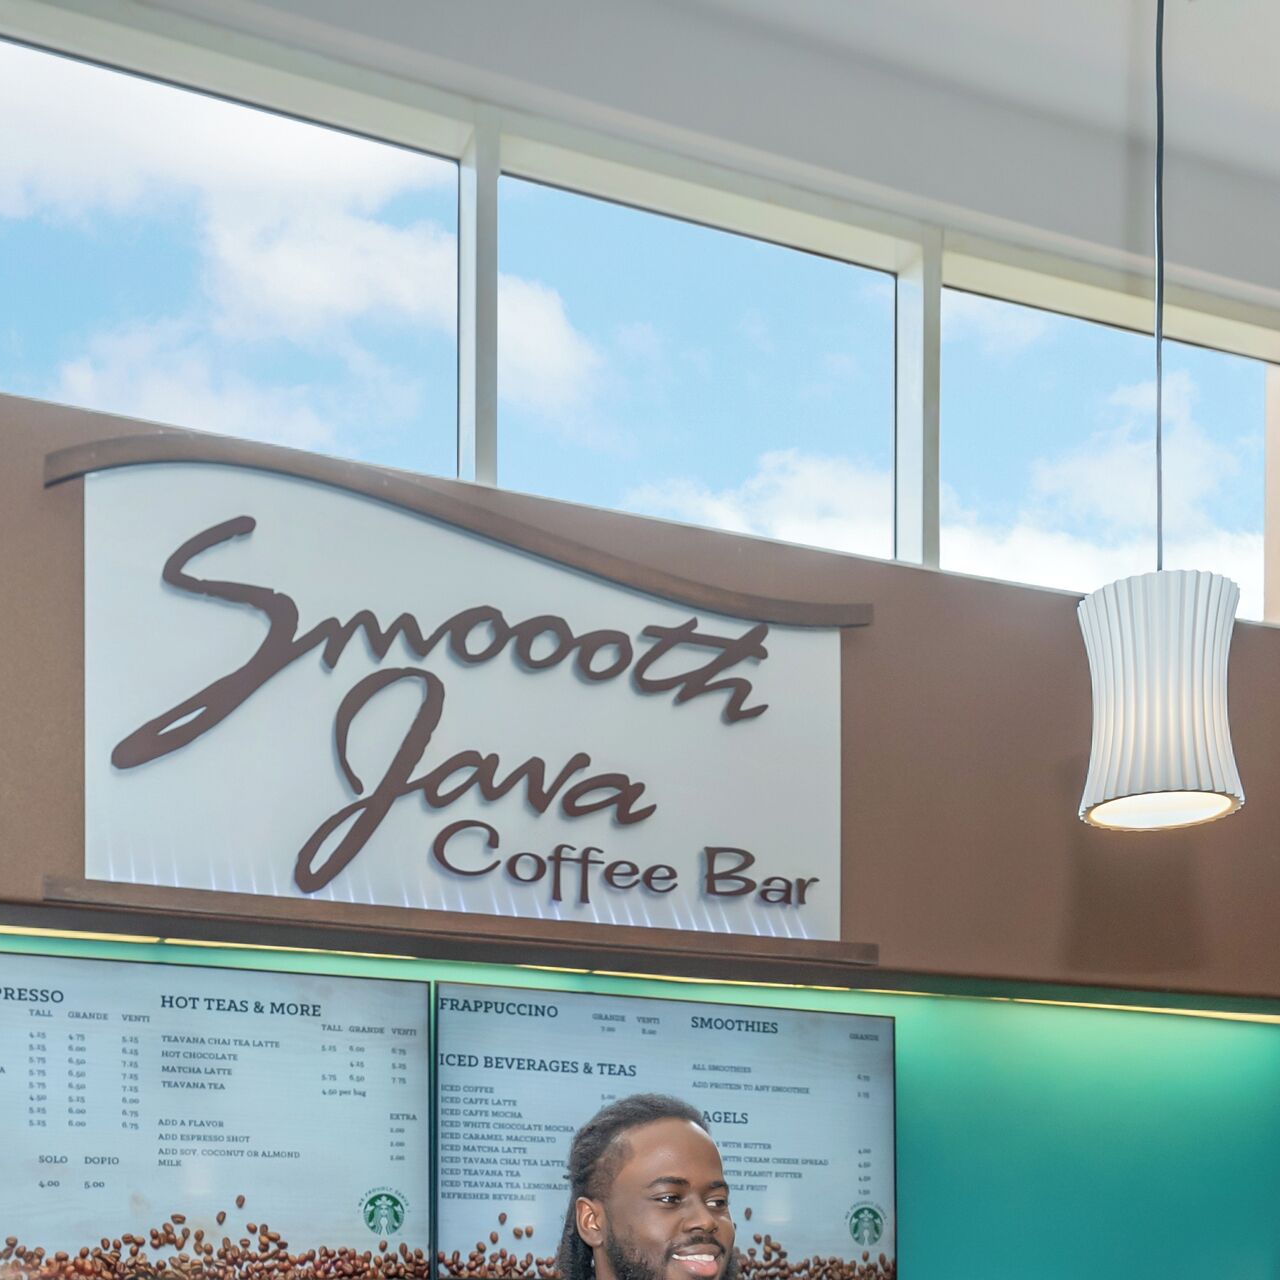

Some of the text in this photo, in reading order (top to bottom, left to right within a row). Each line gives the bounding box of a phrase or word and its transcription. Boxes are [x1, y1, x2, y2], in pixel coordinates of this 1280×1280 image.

[111, 515, 769, 769] Smoooth
[294, 667, 657, 894] Java
[432, 820, 820, 907] Coffee Bar
[161, 996, 322, 1017] HOT TEAS & MORE
[440, 998, 558, 1018] FRAPPUCCINO
[29, 1009, 150, 1023] TALL GRANDE VENTI
[349, 1026, 385, 1034] GRANDE
[691, 1016, 779, 1034] SMOOTHIES
[162, 1035, 280, 1048] TEAVANA CHAI TEA LATTE
[162, 1050, 238, 1061] HOT CHOCOLATE
[162, 1065, 232, 1076] MATCHA LATTE
[440, 1053, 637, 1077] ICED BEVERAGES & TEAS
[162, 1080, 226, 1090] TEAVANA TEA
[441, 1084, 494, 1094] ICED COFFEE
[441, 1096, 517, 1107] ICED CAFFE LATTE
[441, 1108, 523, 1119] ICED CAFFE MOCHA
[702, 1111, 749, 1124] AGELS
[188, 1120, 224, 1128] FLAVOR
[441, 1120, 575, 1133] ICED WHITE CHOCOLATE MOCHA
[180, 1134, 225, 1142] ESPRESSO
[441, 1132, 556, 1144] ICED CARAMEL MACCHIATO
[158, 1148, 178, 1156] ADD
[247, 1150, 259, 1158] OR
[261, 1151, 300, 1159] ALMOND
[441, 1144, 527, 1154] ICED MATCHA LATTE
[39, 1155, 120, 1165] SOLO DOPIO
[540, 1160, 566, 1168] LATTE
[441, 1168, 521, 1178] ICED TEAVANA TEA
[39, 1180, 105, 1189] 4.00 5.00
[441, 1180, 461, 1188] ICED
[463, 1181, 503, 1189] TEAVANA
[441, 1192, 490, 1200] REFRESHER
